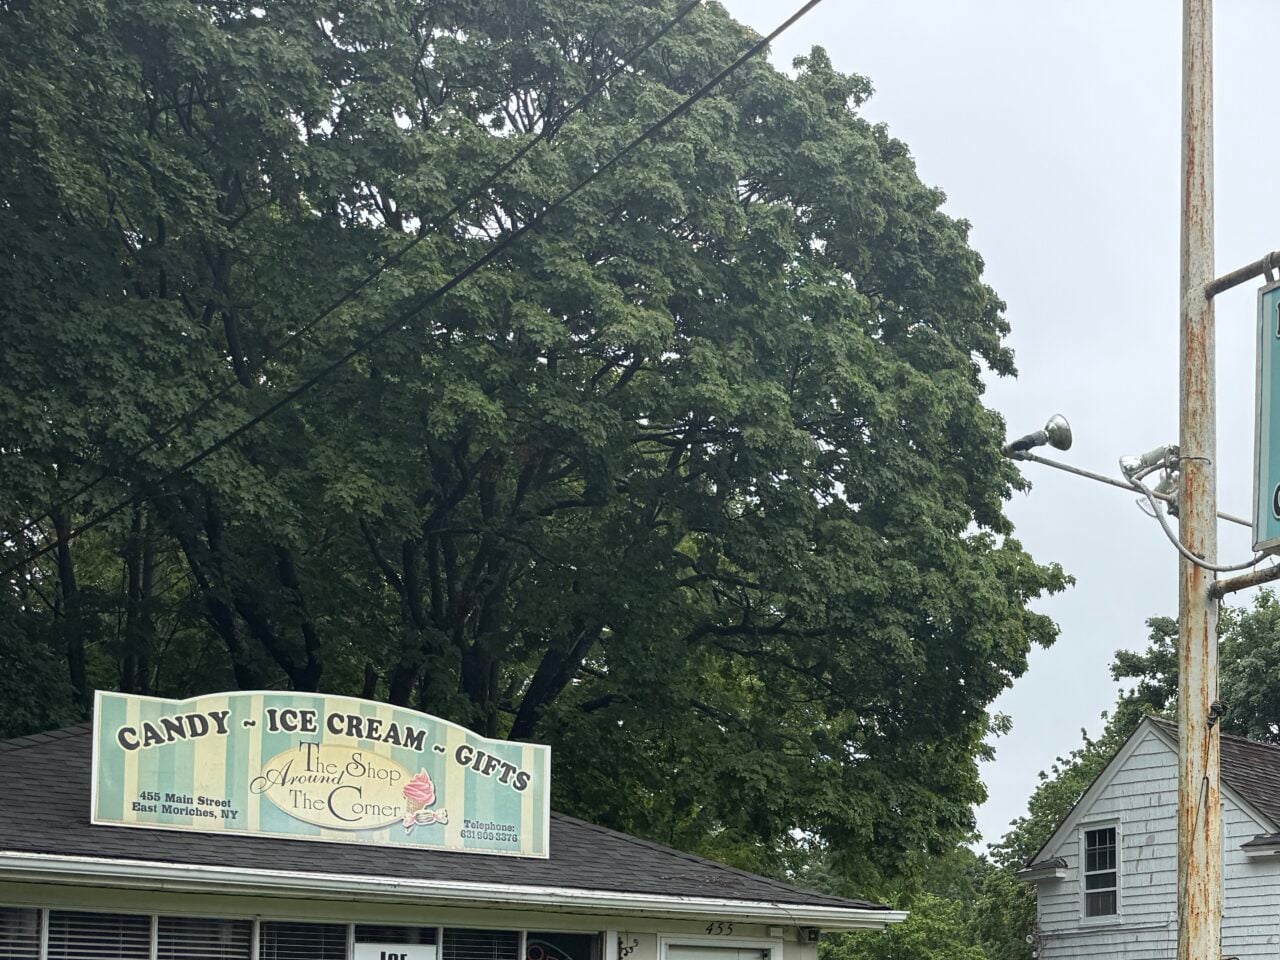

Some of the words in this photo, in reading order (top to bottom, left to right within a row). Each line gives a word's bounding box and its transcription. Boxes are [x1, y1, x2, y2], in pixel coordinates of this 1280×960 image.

[117, 710, 231, 751] CANDY
[266, 708, 318, 733] ICE
[326, 712, 427, 752] CREAM
[455, 744, 531, 791] GIFTS
[299, 740, 338, 774] The
[345, 752, 402, 786] Shop
[249, 758, 345, 795] Around
[131, 801, 158, 813] East
[161, 804, 217, 820] Moriches,
[220, 809, 239, 820] NY
[139, 790, 161, 802] 455
[165, 793, 194, 805] Main
[197, 795, 232, 808] Street
[289, 788, 326, 811] The
[327, 785, 401, 822] Corner
[463, 819, 515, 833] Telephone:
[705, 922, 734, 936] 455
